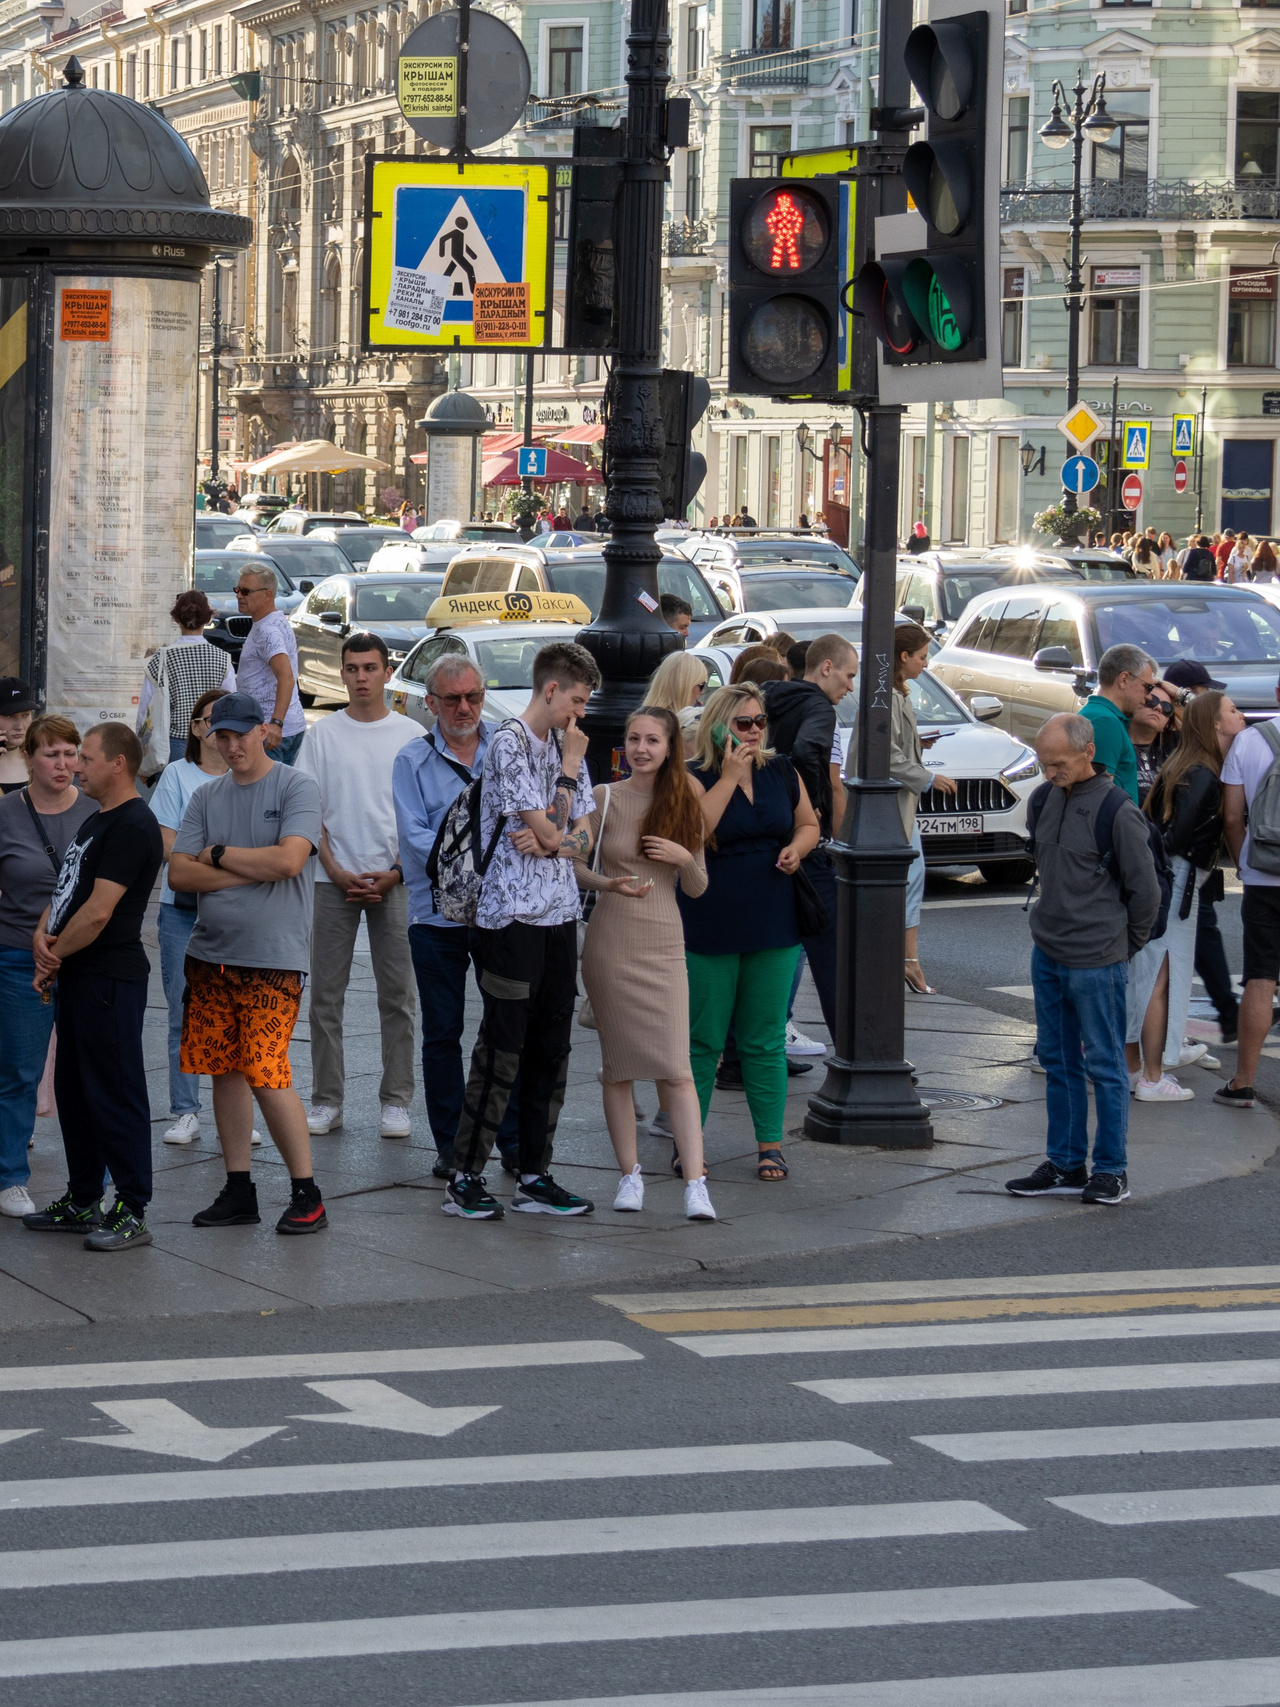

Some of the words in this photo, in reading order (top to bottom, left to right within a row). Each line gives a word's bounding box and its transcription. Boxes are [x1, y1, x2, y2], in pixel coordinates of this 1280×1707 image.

[403, 71, 453, 81] КРЫШАМ
[403, 94, 453, 102] +7977-652-88-54
[163, 246, 186, 257] Russ
[399, 277, 426, 286] КРЫШИ
[397, 289, 414, 298] РЕКИ
[398, 283, 436, 295] ПАРАДНЫЕ
[476, 287, 514, 298] ЭКСКУРСИИ
[516, 287, 525, 297] ПО
[65, 301, 107, 310] КРЫШАМ
[396, 295, 424, 305] КАНАЛЫ
[480, 299, 526, 309] КРЫШАМ
[398, 310, 410, 319] 981
[411, 312, 423, 321] 284
[424, 315, 432, 324] 57
[433, 317, 441, 325] 00
[480, 310, 526, 318] ПАРАДНЫМ
[395, 319, 430, 330] roofgo.ru
[448, 599, 502, 614] Яндекс
[507, 595, 530, 610] Go
[533, 595, 574, 611] Такси
[959, 818, 978, 828] 198
[253, 994, 278, 1010] 200
[260, 1016, 281, 1038] 100
[205, 1036, 229, 1054] 6AM
[266, 1041, 278, 1058] 200
[203, 1049, 211, 1058] B
[261, 1066, 273, 1079] 900
